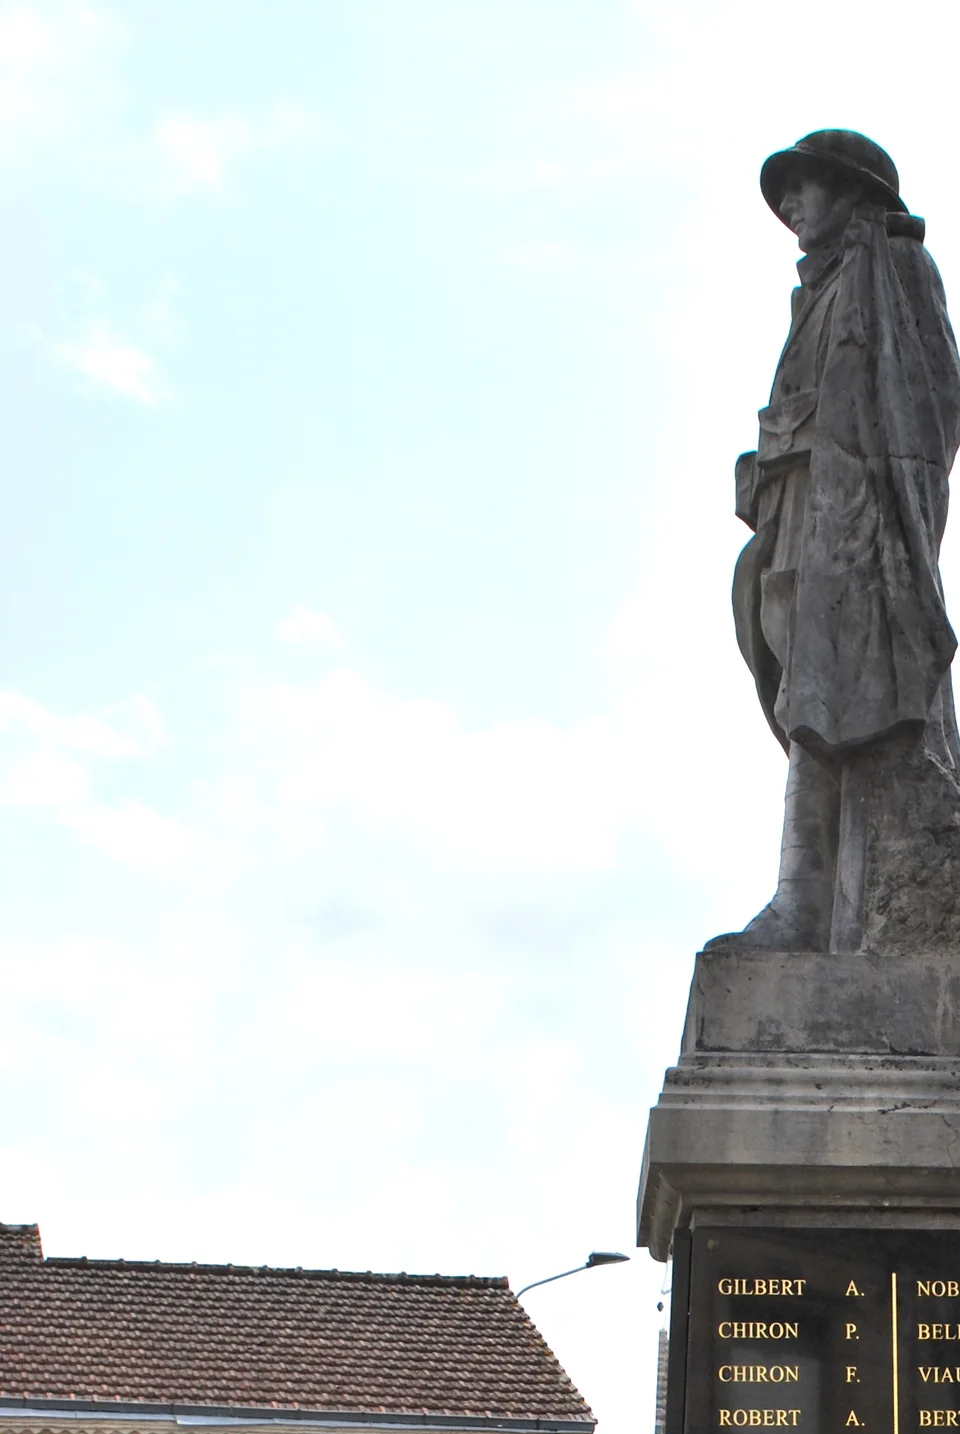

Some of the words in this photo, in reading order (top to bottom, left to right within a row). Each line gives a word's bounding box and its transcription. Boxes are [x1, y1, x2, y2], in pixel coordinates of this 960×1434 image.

[717, 1278, 806, 1296] GILBERT
[845, 1279, 865, 1297] A.
[717, 1322, 799, 1339] CHIRON
[845, 1322, 860, 1339] P.
[718, 1365, 799, 1383] CHIRON
[846, 1365, 861, 1383] F.
[719, 1409, 801, 1427] ROBERT
[845, 1409, 866, 1427] A.
